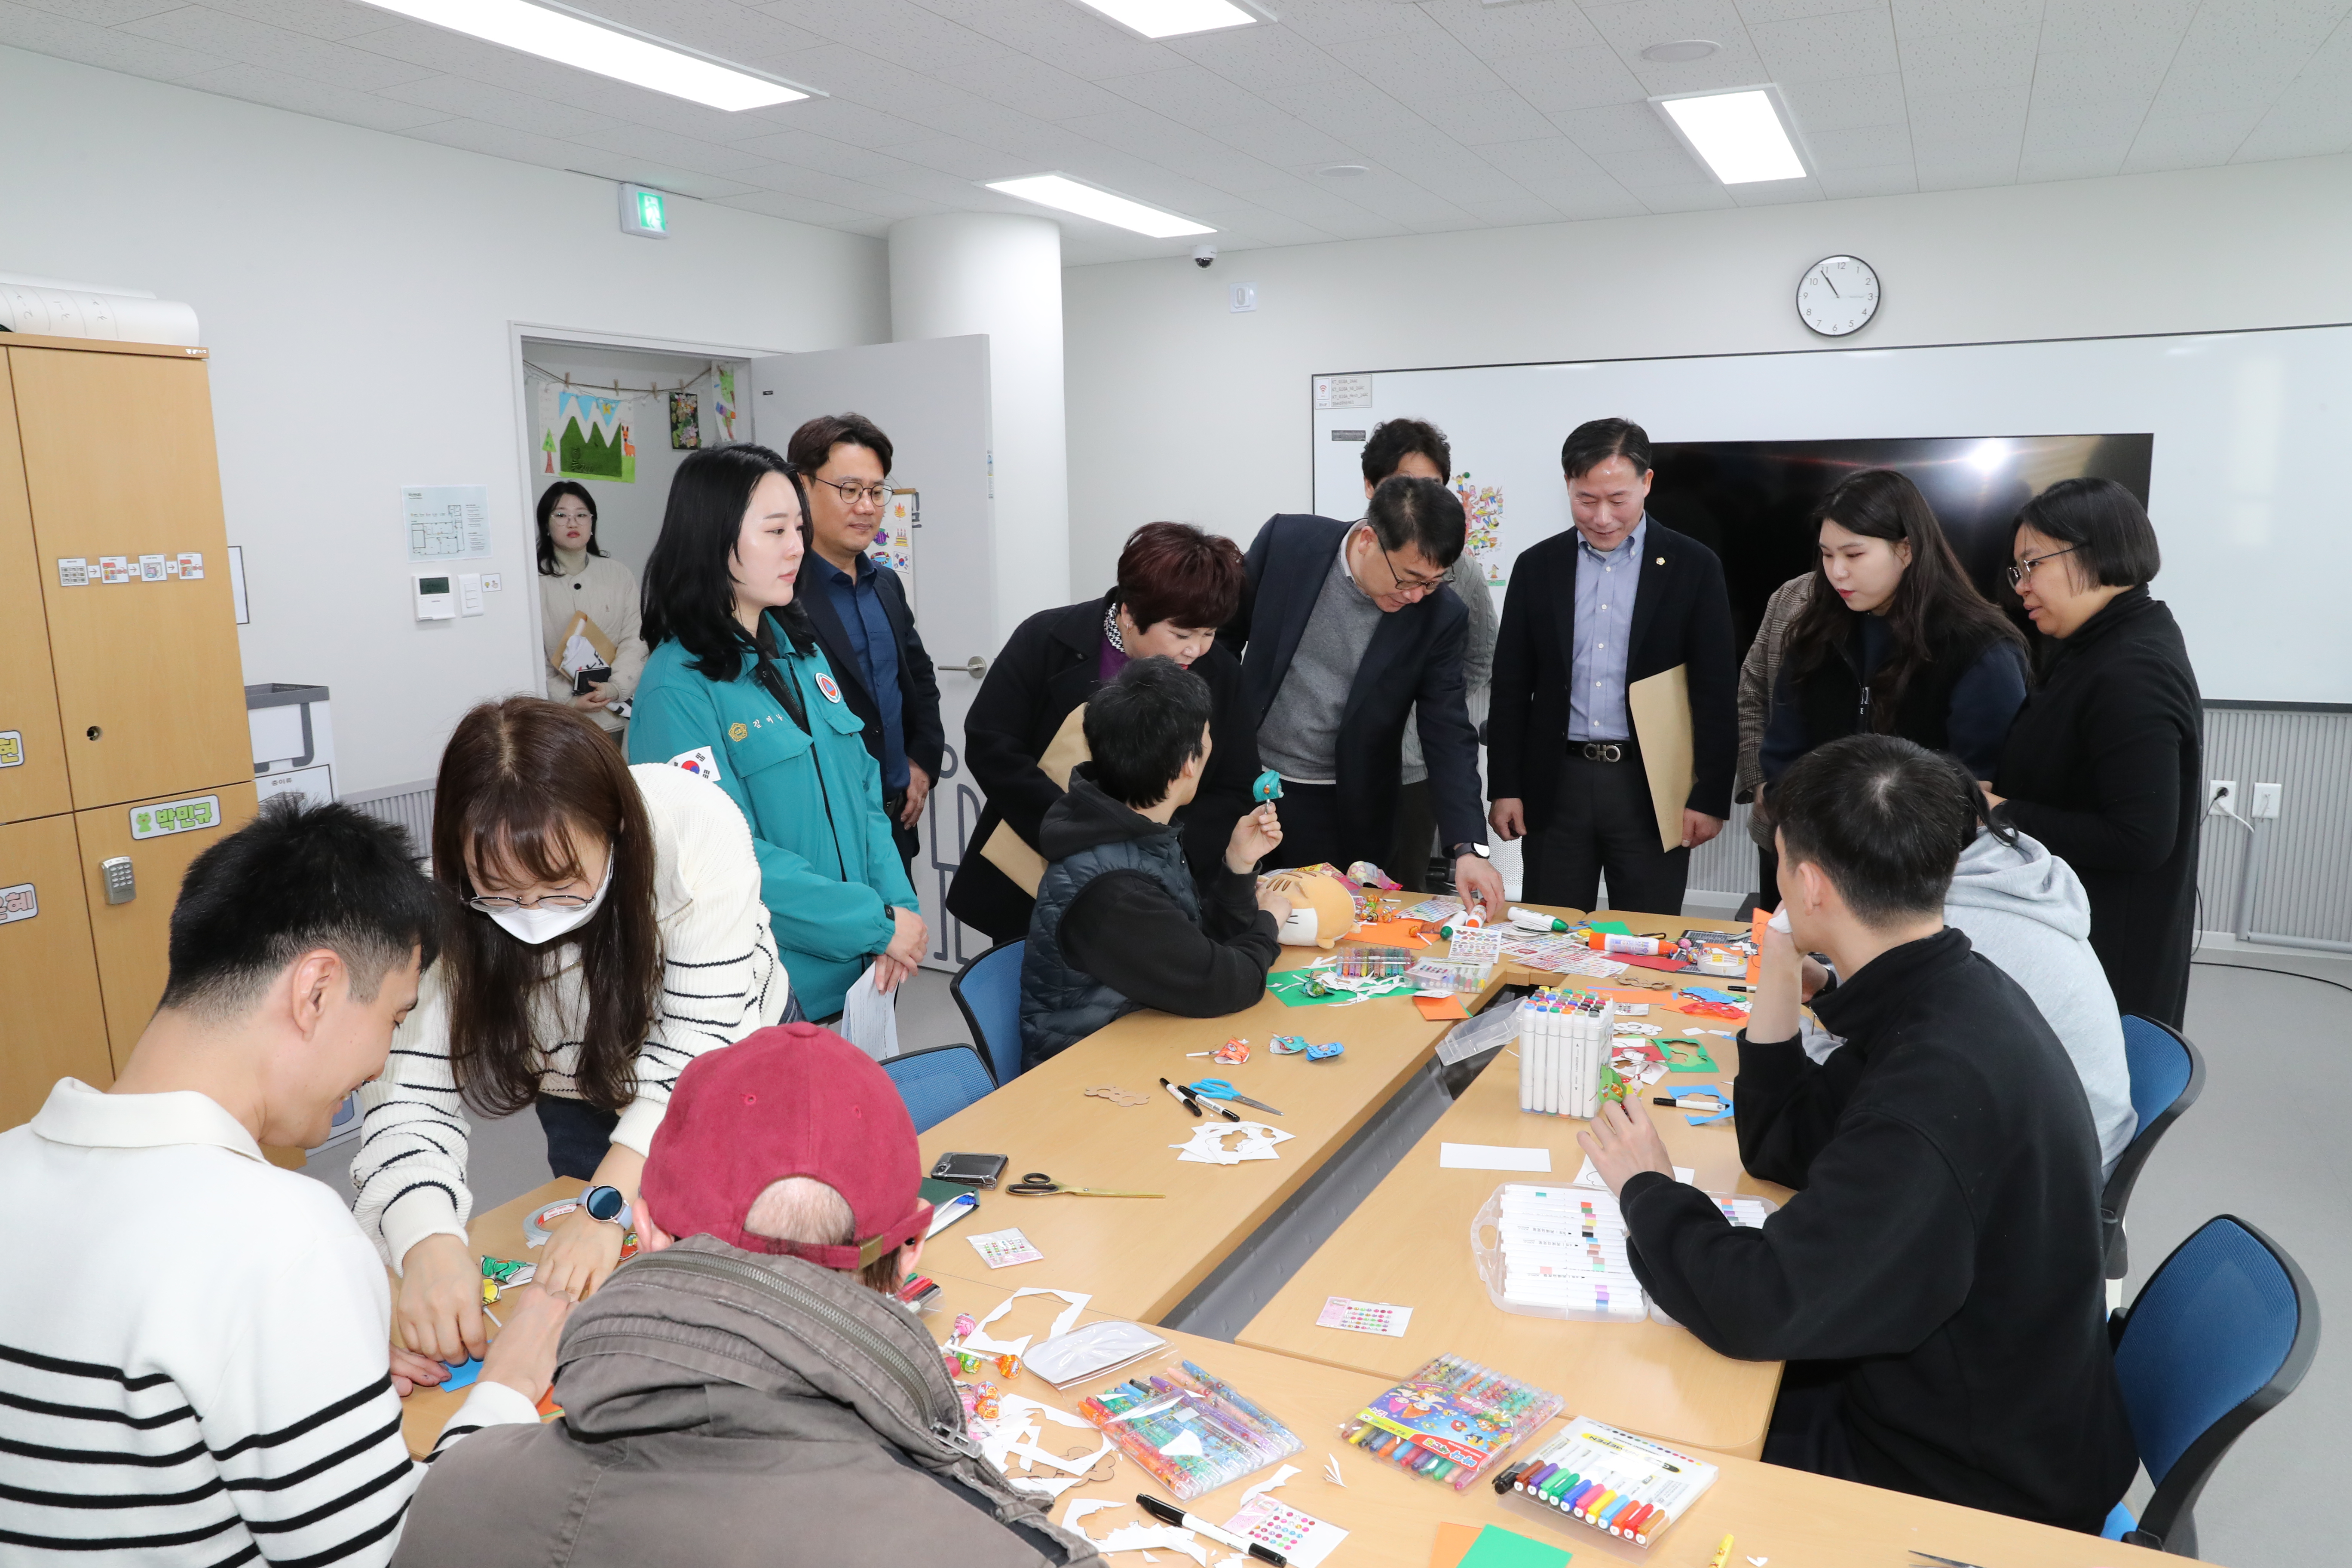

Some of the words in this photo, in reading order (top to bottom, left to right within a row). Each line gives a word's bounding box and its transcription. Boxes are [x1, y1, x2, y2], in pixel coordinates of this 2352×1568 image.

[271, 778, 292, 786] 종이류
[156, 801, 212, 831] 박민규
[1372, 1419, 1396, 1432] MUNGYO
[1448, 1441, 1464, 1451] CRAYON
[1589, 1436, 1640, 1456] NAMEPEN
[1450, 1452, 1476, 1467] 바다
